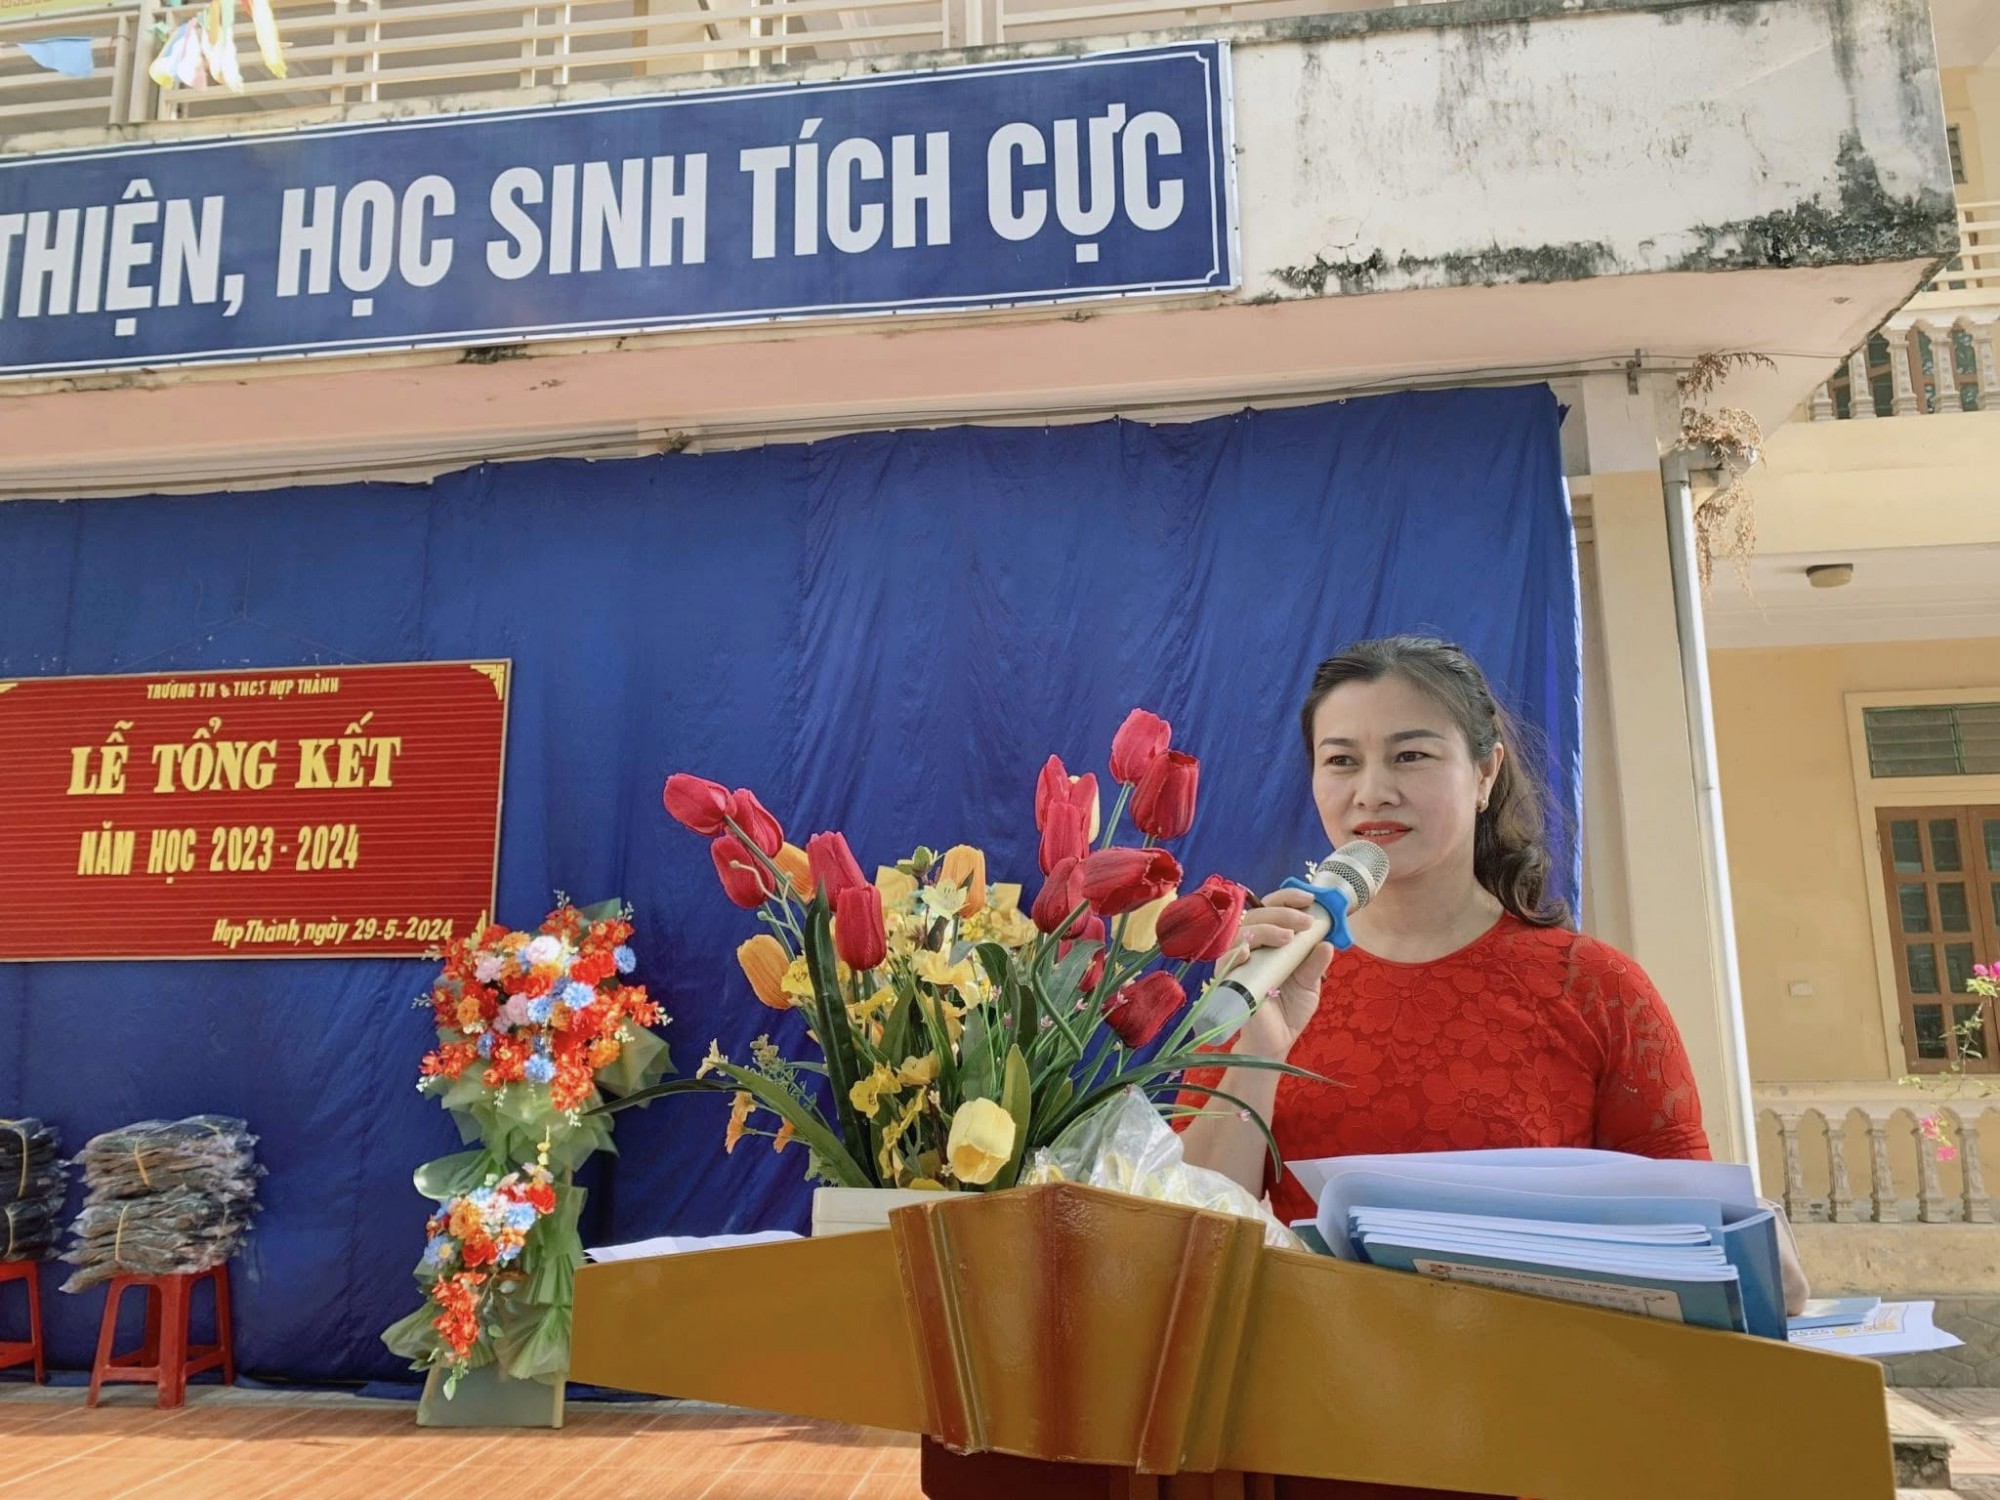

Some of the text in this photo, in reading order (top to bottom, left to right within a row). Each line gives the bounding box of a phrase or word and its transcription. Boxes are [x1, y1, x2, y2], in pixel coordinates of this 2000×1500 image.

[276, 175, 456, 317] HỌC
[486, 148, 708, 279] SINH
[740, 117, 951, 259] TÍCH
[987, 103, 1185, 263] CỰC
[147, 679, 196, 699] TRƯỜNG
[199, 682, 216, 698] TH
[233, 680, 267, 696] THCS
[269, 679, 294, 700] HỢP
[297, 672, 340, 694] THÀNH
[66, 711, 402, 795] LỄ TỔNG KẾT
[77, 821, 135, 876] NĂM
[147, 827, 197, 884] HỌC
[209, 826, 275, 872] 2023
[295, 824, 360, 871] 2024
[303, 915, 350, 945] ngày
[351, 916, 454, 942] 29-5-2024
